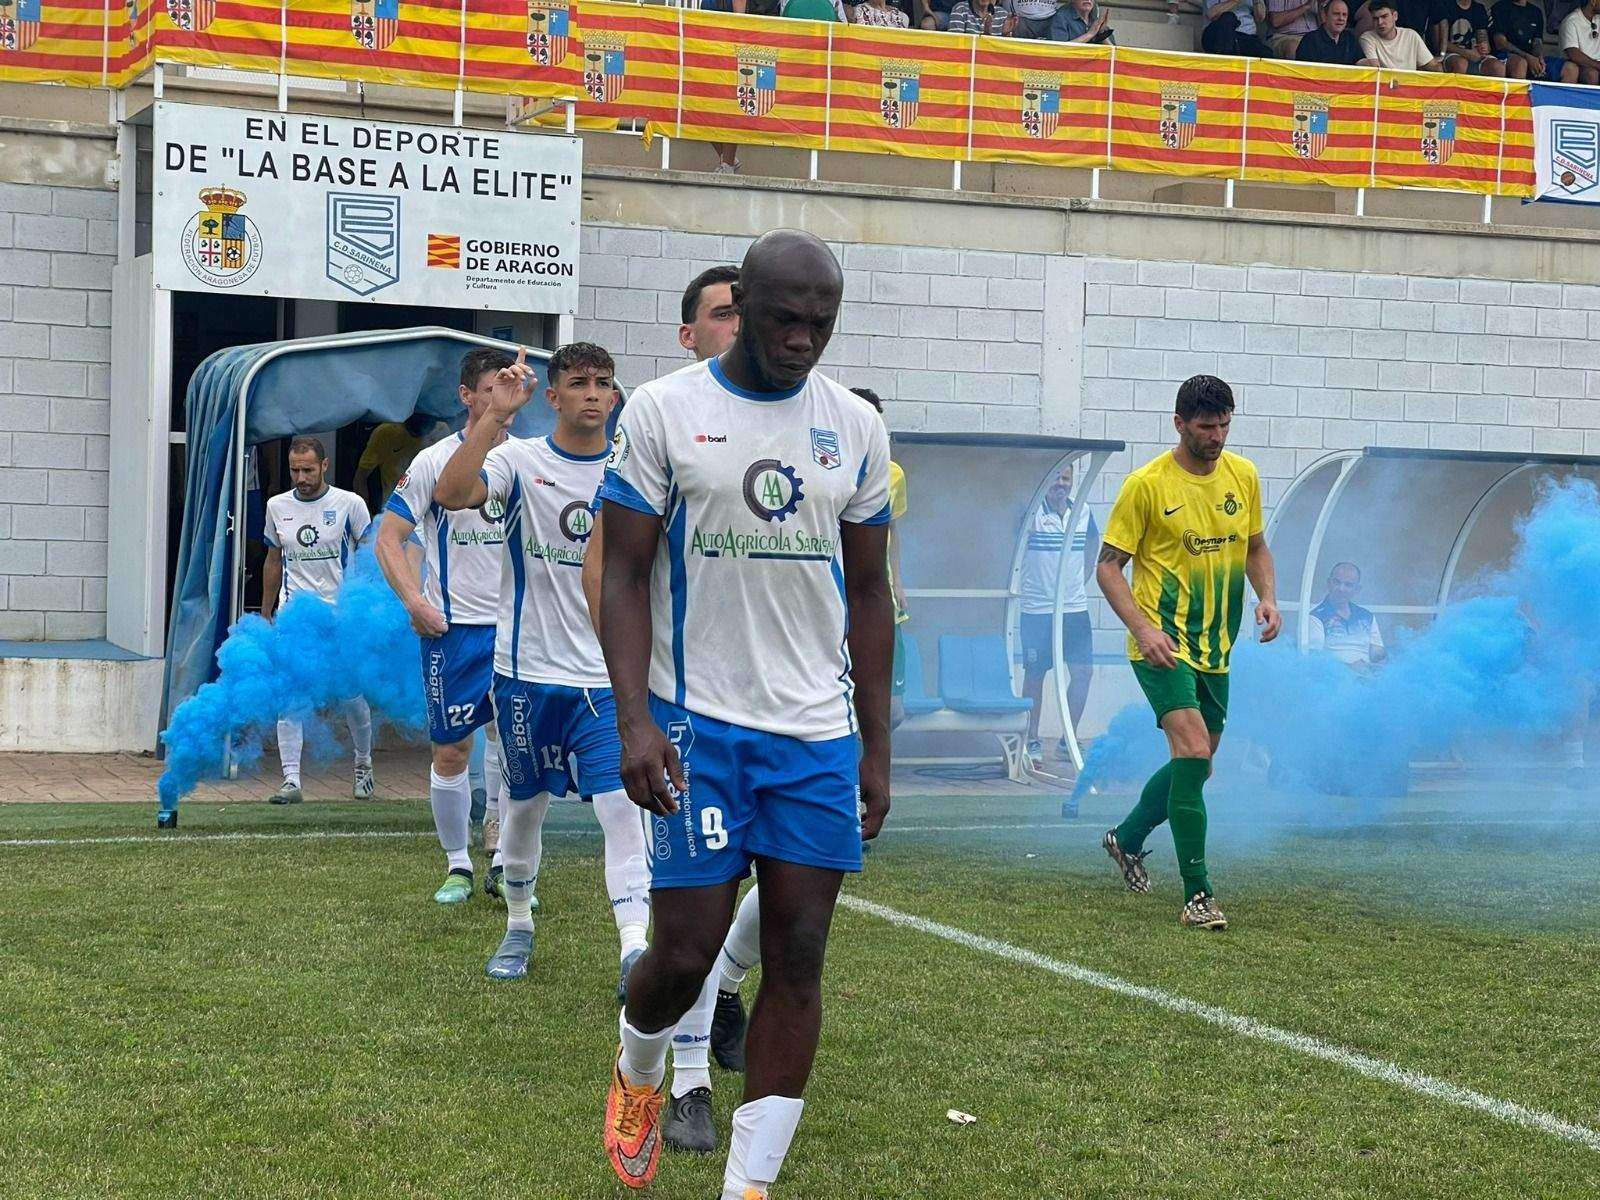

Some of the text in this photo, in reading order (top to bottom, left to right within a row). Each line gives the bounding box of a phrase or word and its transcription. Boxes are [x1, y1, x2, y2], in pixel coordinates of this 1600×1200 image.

[247, 118, 500, 160] EN EL DEPORTE
[166, 143, 571, 201] DE "LA BASE A LA ELITE"
[467, 239, 560, 258] GOBIERNO
[467, 257, 489, 271] DE
[466, 276, 515, 285] Departamento
[429, 653, 441, 704] hogar
[447, 703, 475, 727] 22
[512, 698, 529, 754] hogar
[541, 744, 565, 771] 12
[701, 806, 729, 850] 9
